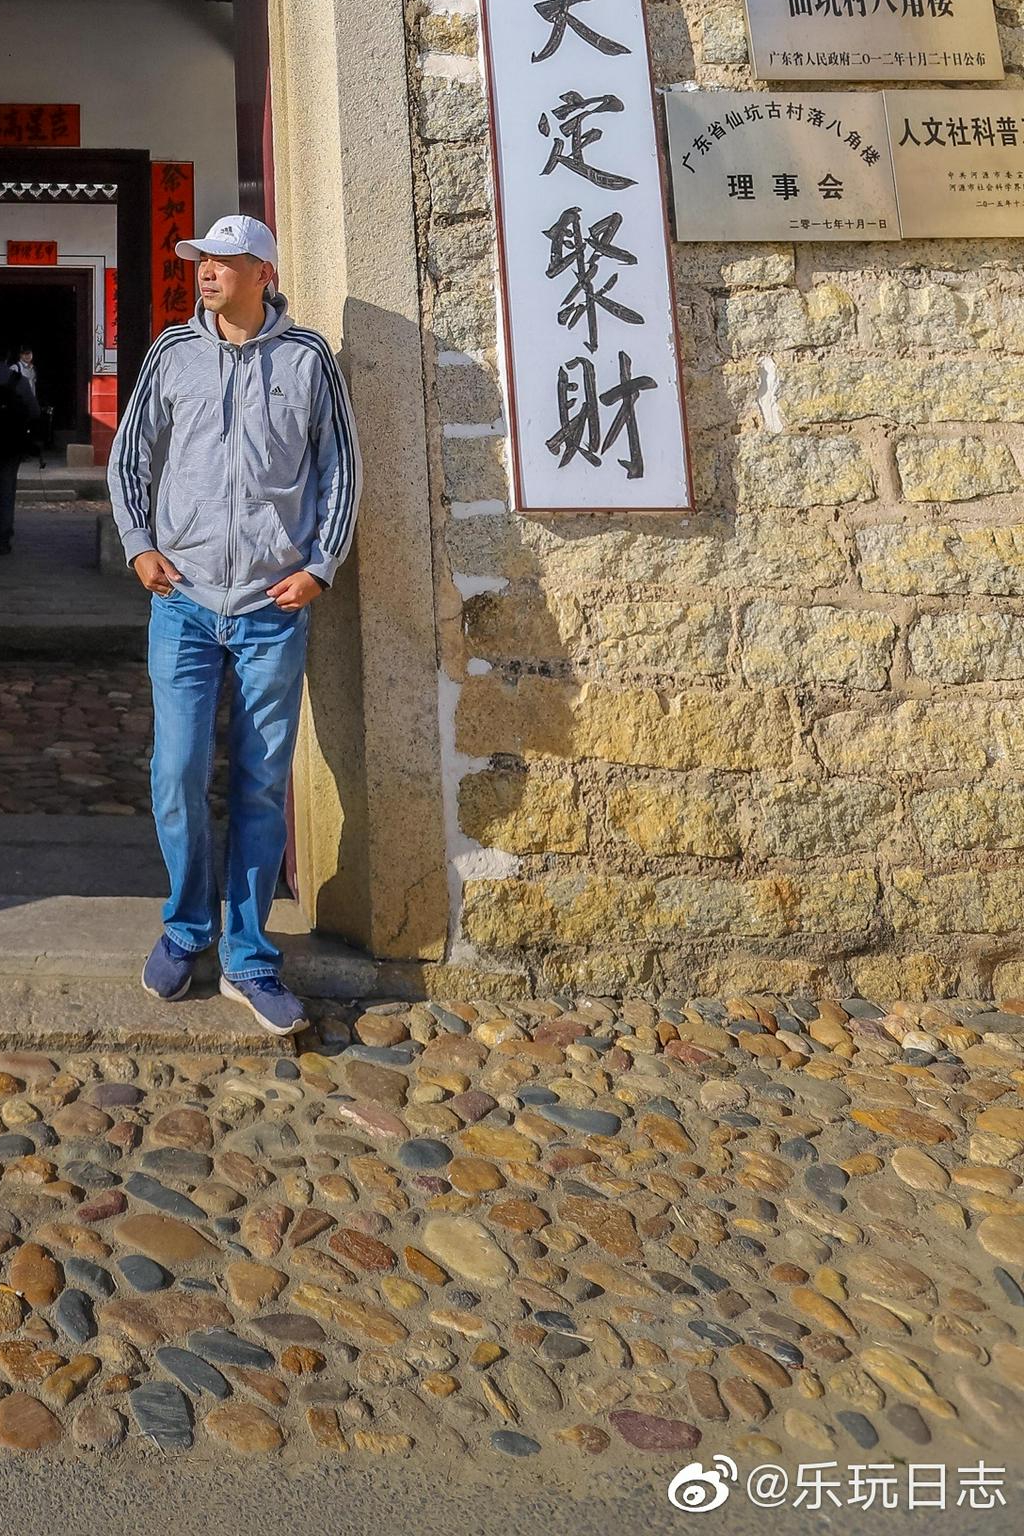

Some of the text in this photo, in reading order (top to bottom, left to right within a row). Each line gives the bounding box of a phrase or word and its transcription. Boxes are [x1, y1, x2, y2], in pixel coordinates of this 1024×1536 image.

[682, 101, 880, 174] 广东省仙坑古村落八角楼
[899, 116, 1024, 147] 人文社科普
[727, 173, 844, 201] 理事会
[950, 183, 1024, 192] 河源市社会科学界
[789, 219, 887, 229] 二零一七年十月一日
